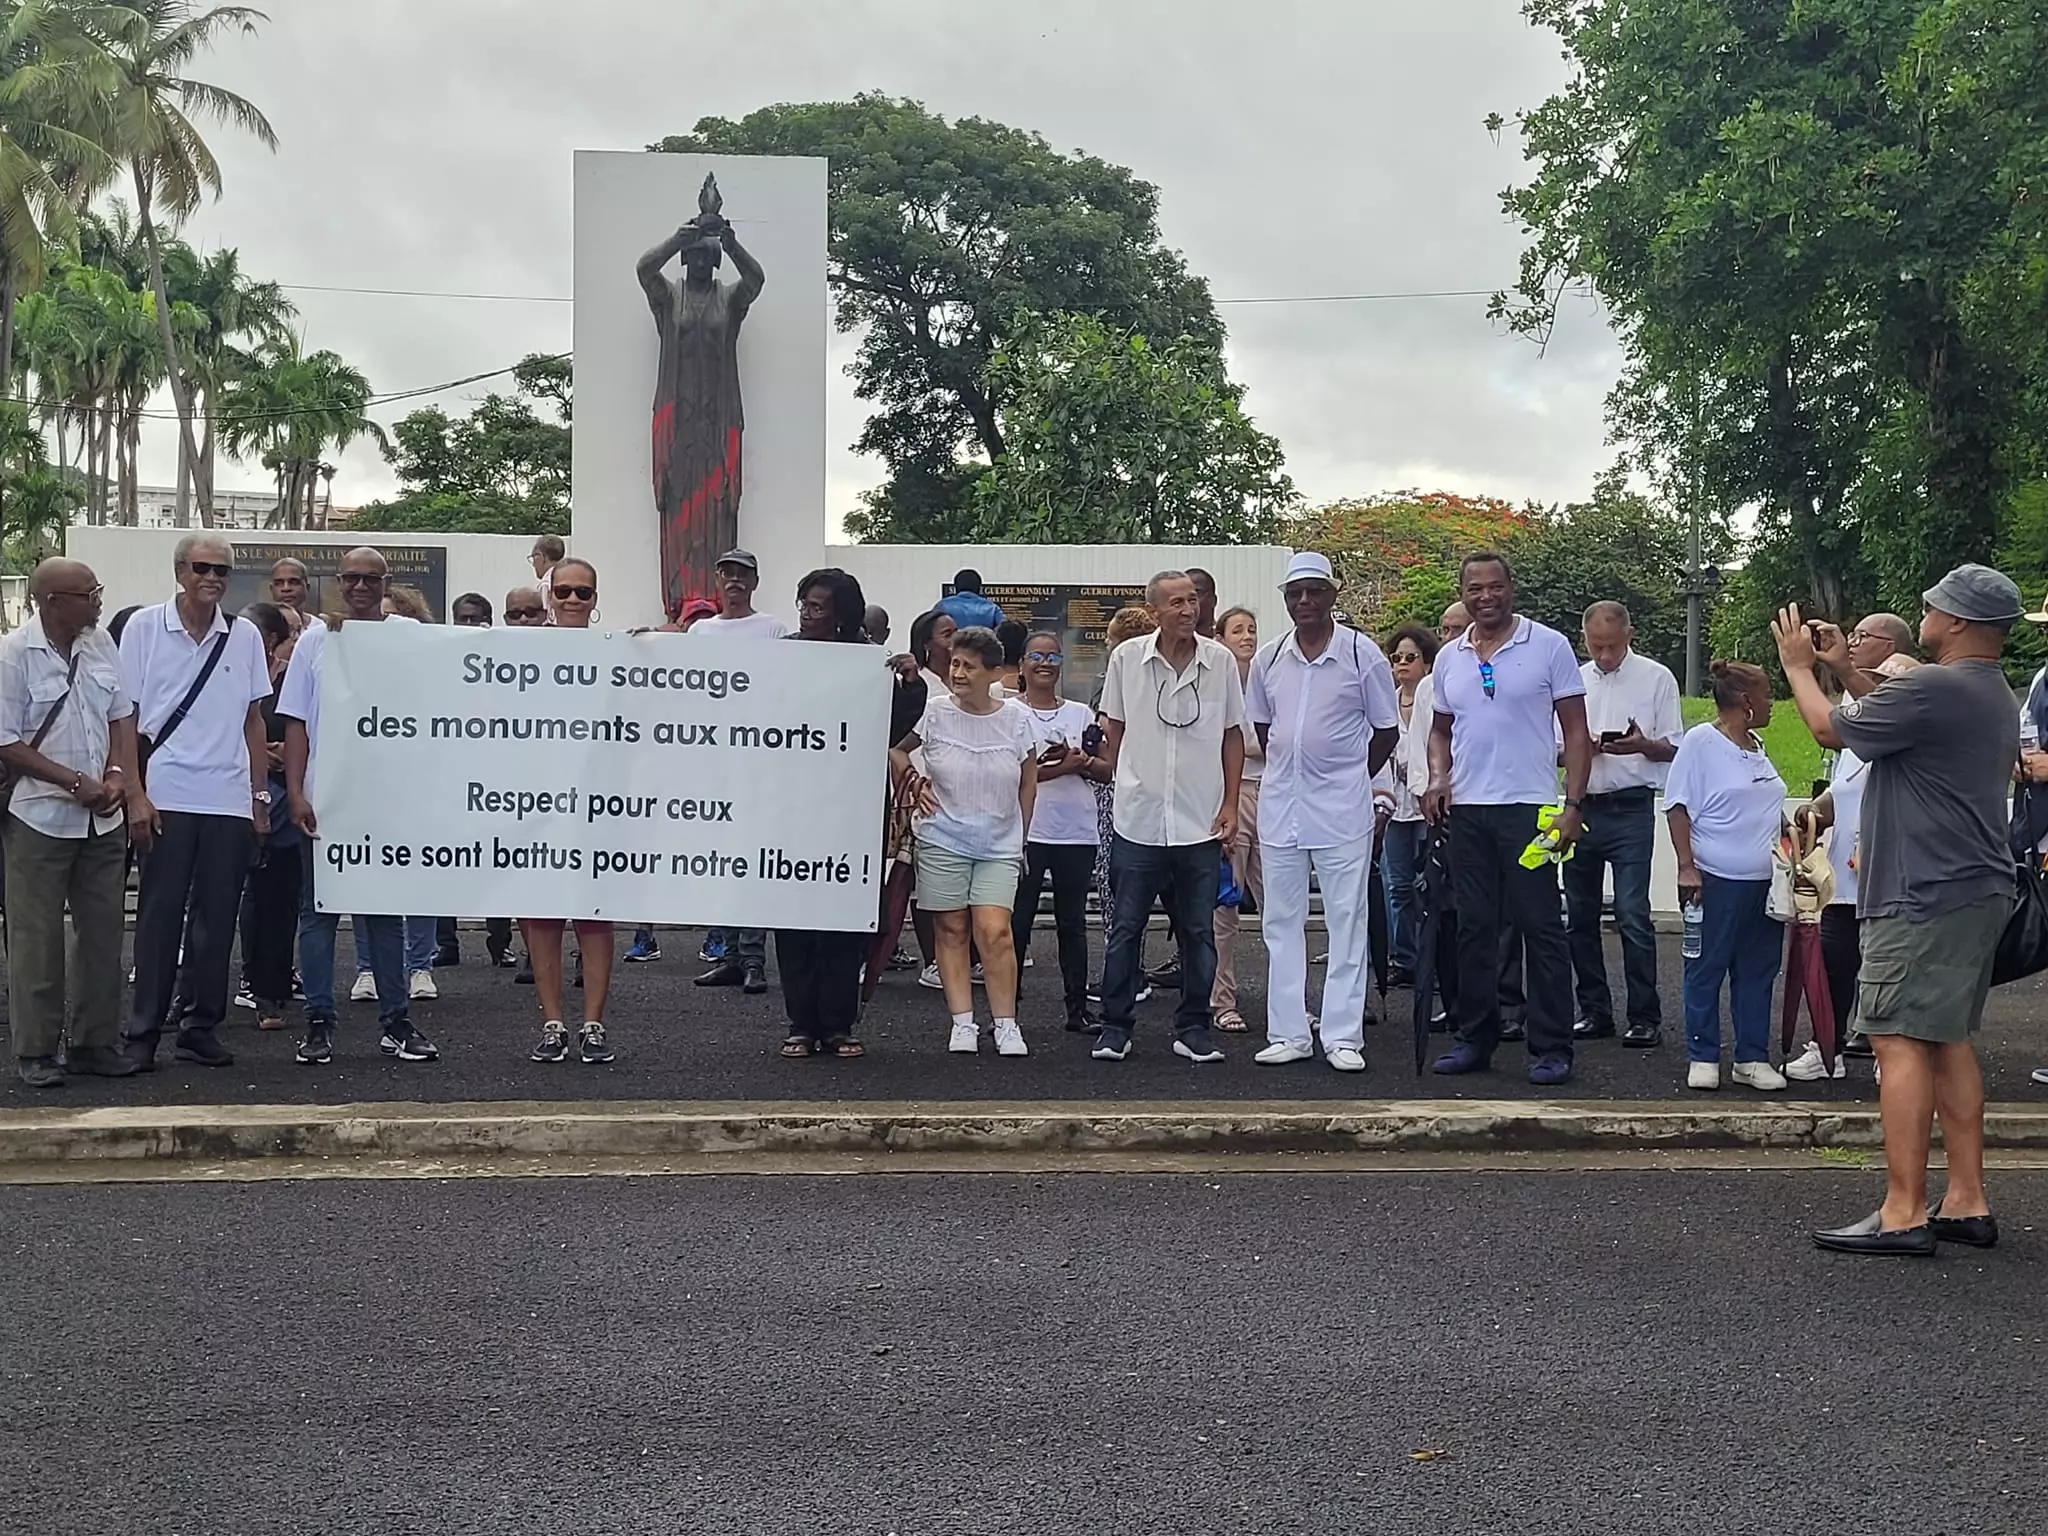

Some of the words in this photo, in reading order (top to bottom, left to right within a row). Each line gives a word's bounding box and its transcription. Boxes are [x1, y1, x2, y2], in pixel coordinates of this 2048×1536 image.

[249, 548, 263, 559] LE
[984, 586, 1015, 595] GUERRE
[1015, 586, 1056, 596] MONDIALE
[1080, 587, 1113, 596] GUERRE
[1113, 587, 1146, 596] D'INDOC
[1085, 632, 1107, 640] GUER
[463, 653, 540, 691] Stop
[554, 665, 597, 686] au
[611, 665, 750, 699] saccage
[357, 706, 417, 739] des
[431, 715, 640, 743] monuments
[654, 723, 717, 746] aux
[730, 724, 825, 751] morts
[840, 722, 847, 752] !
[468, 782, 578, 820] Respect
[588, 794, 657, 823] pour
[667, 799, 733, 822] ceux
[327, 834, 371, 873] qui
[381, 845, 411, 867] se
[421, 841, 482, 869] sont
[493, 837, 582, 870] battus
[593, 851, 662, 879] pour
[672, 850, 748, 879] notre
[758, 848, 850, 884] liberté
[862, 853, 869, 884] !
